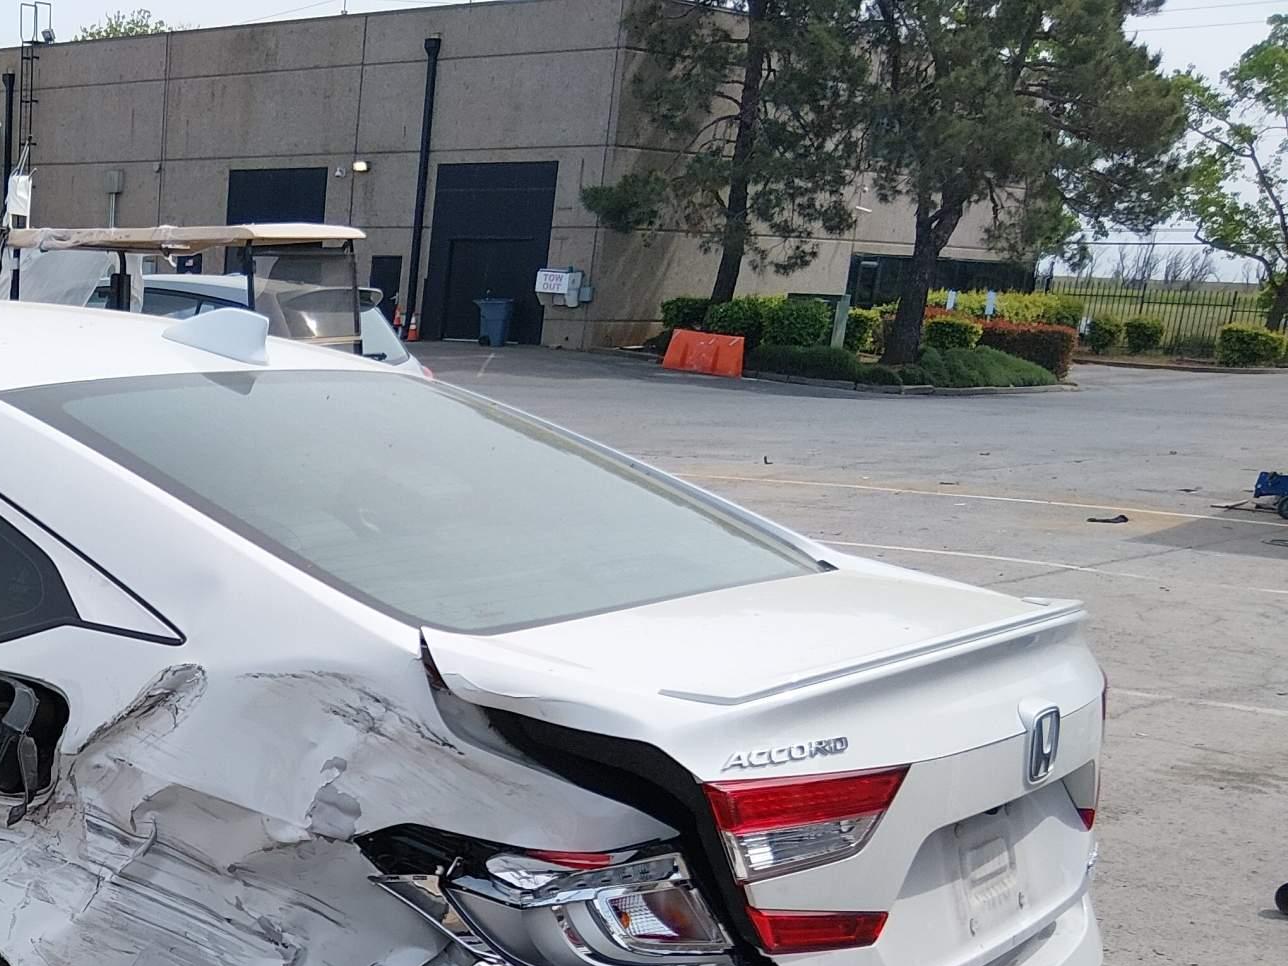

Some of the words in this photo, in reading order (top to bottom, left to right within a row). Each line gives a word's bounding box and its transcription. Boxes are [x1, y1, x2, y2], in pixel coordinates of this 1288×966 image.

[543, 273, 564, 282] TOW
[542, 282, 562, 291] OUT
[721, 736, 849, 772] ACCORD
